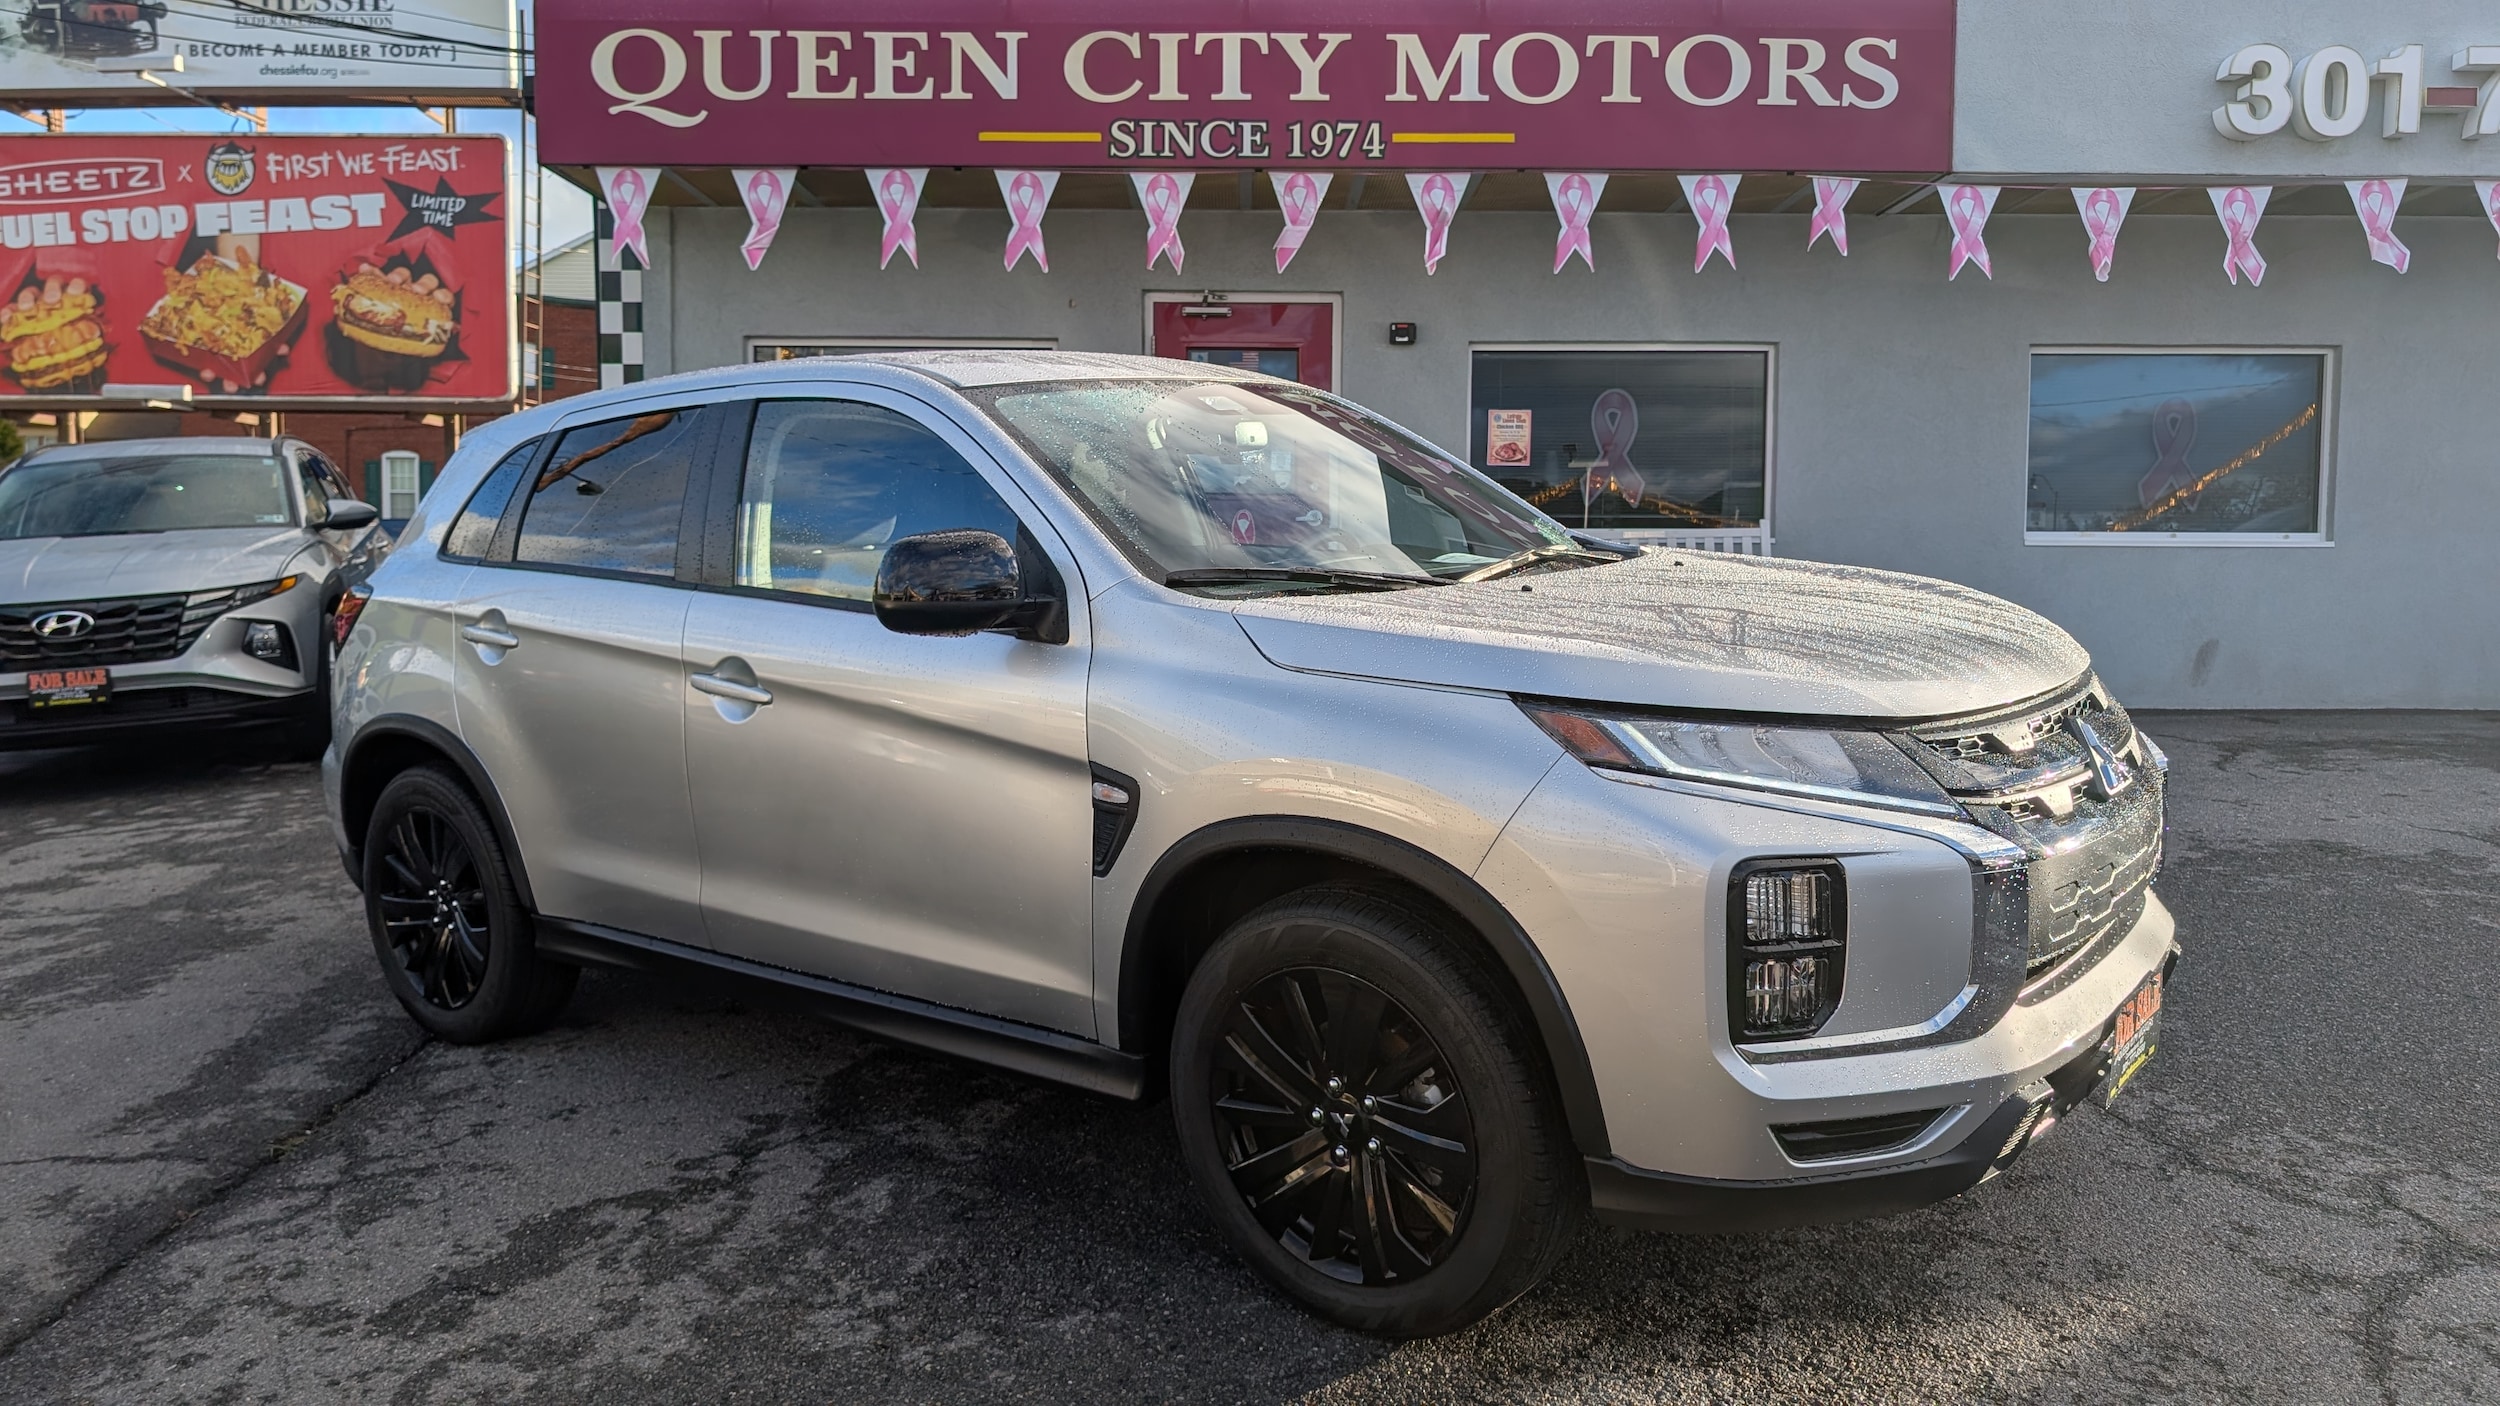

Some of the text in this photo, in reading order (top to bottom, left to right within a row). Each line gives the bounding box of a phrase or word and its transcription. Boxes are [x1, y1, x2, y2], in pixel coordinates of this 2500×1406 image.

[189, 44, 264, 58] BECOME
[273, 44, 285, 57] A
[294, 44, 371, 58] MEMBER
[380, 44, 443, 58] TODAY
[590, 28, 1900, 128] QUEEN CITY MOTORS
[1108, 118, 1388, 160] SINCE 1974
[265, 151, 334, 184] FIRST
[336, 149, 376, 177] WE
[378, 144, 463, 175] FEAST
[411, 193, 466, 213] LIMITED
[422, 210, 454, 227] TIME
[0, 192, 386, 249] UEL STOP FEAST
[28, 667, 107, 691] FOR SALE
